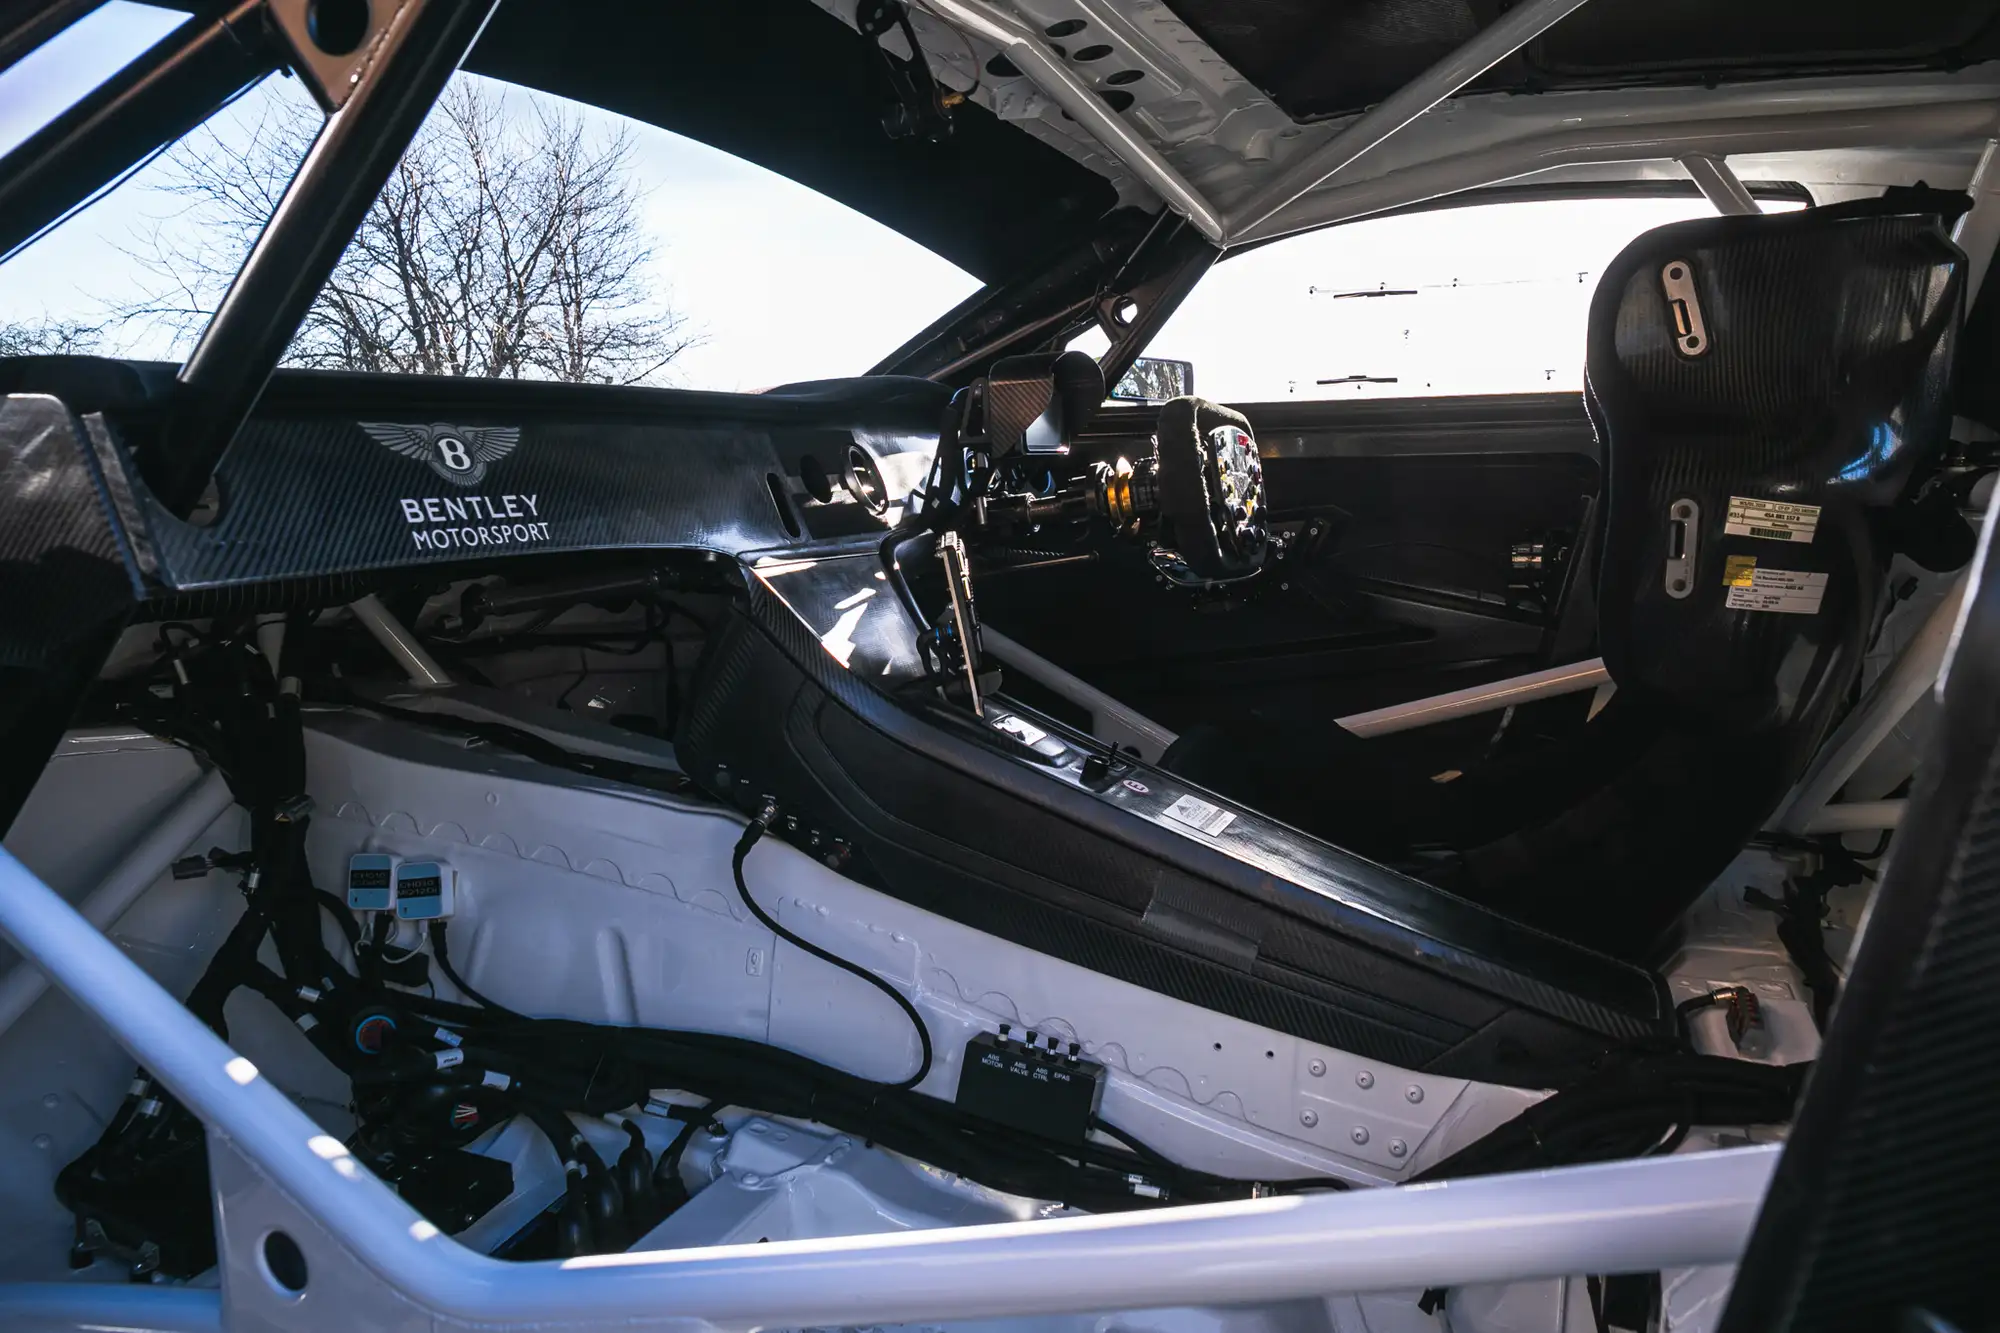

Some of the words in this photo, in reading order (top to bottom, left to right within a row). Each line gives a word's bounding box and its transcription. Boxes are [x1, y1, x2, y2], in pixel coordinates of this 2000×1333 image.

[438, 438, 471, 470] B
[401, 494, 538, 523] BENTLEY
[412, 522, 550, 550] MOTORSPORT
[988, 1053, 1000, 1061] ABS
[982, 1058, 1003, 1069] MOTOR
[1014, 1061, 1027, 1069] ABS
[1009, 1066, 1029, 1077] VALVE
[1035, 1067, 1048, 1075] ABS
[1033, 1072, 1048, 1082] CTRL
[1054, 1072, 1071, 1081] EPAS
